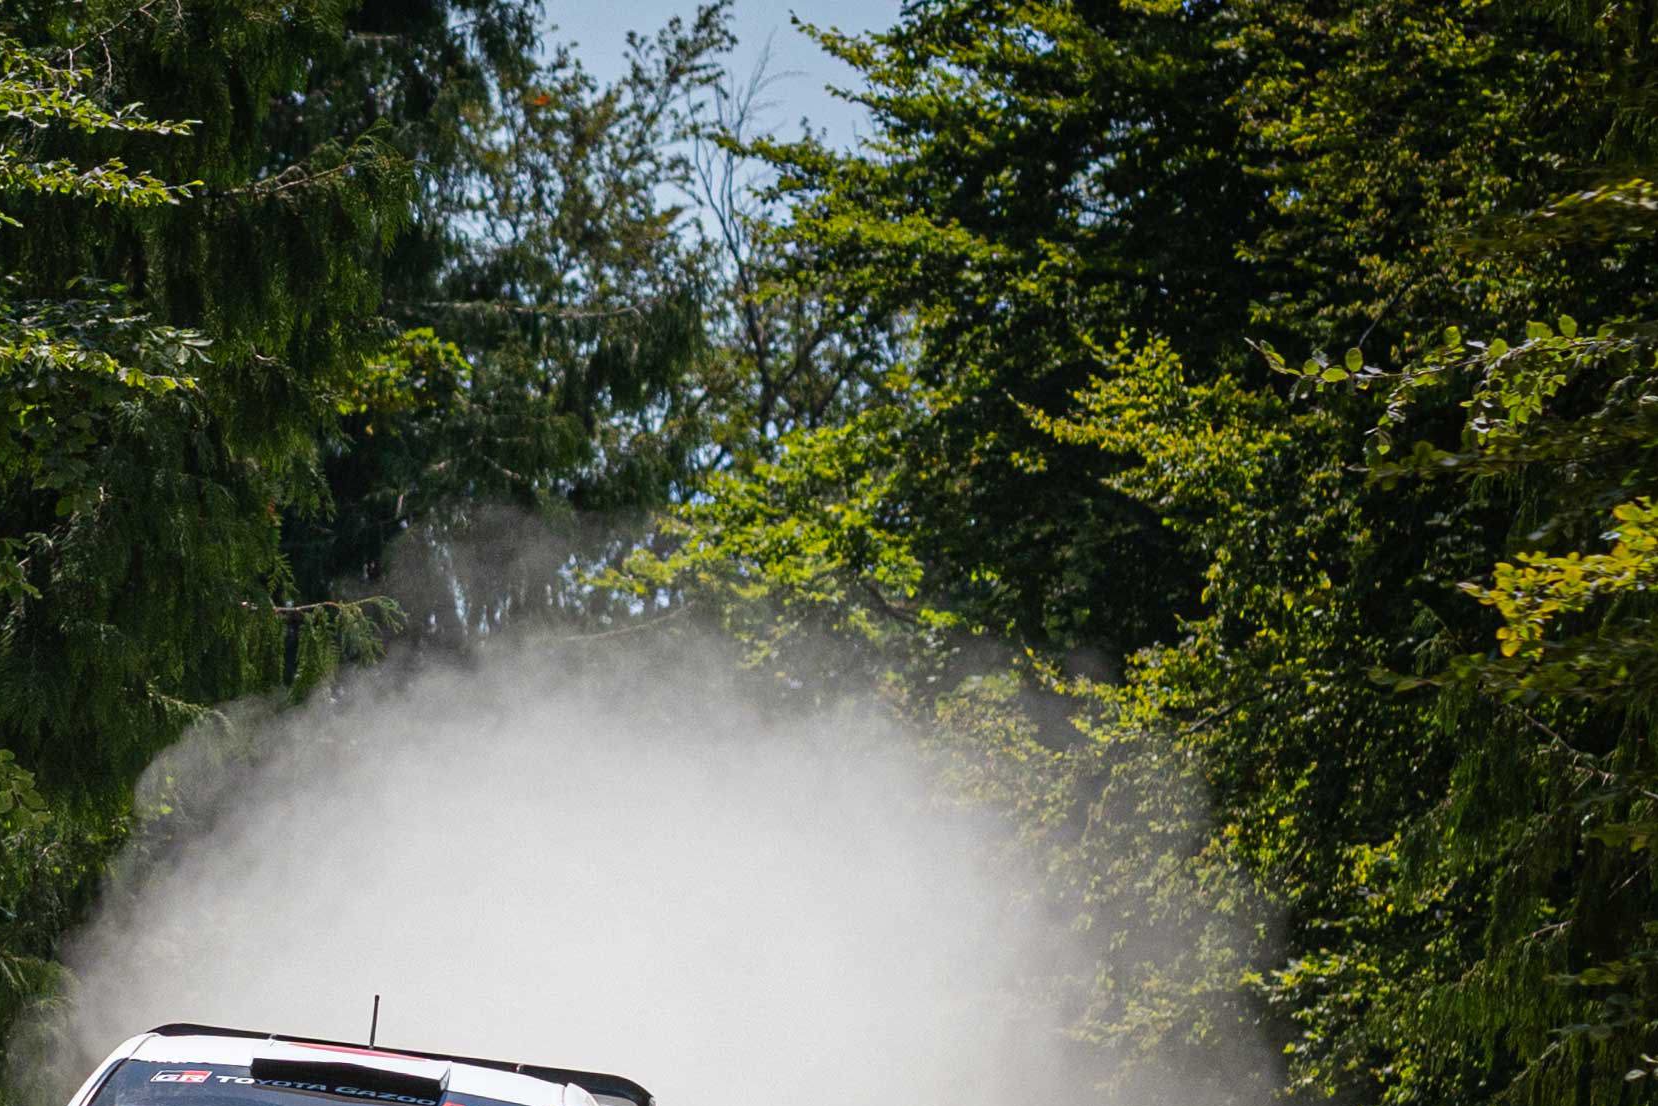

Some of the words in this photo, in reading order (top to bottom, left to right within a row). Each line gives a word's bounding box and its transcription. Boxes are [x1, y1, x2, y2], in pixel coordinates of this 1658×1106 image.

[153, 1071, 208, 1083] GR
[216, 1075, 327, 1092] TOYOTA
[335, 1086, 437, 1106] GAZOO
